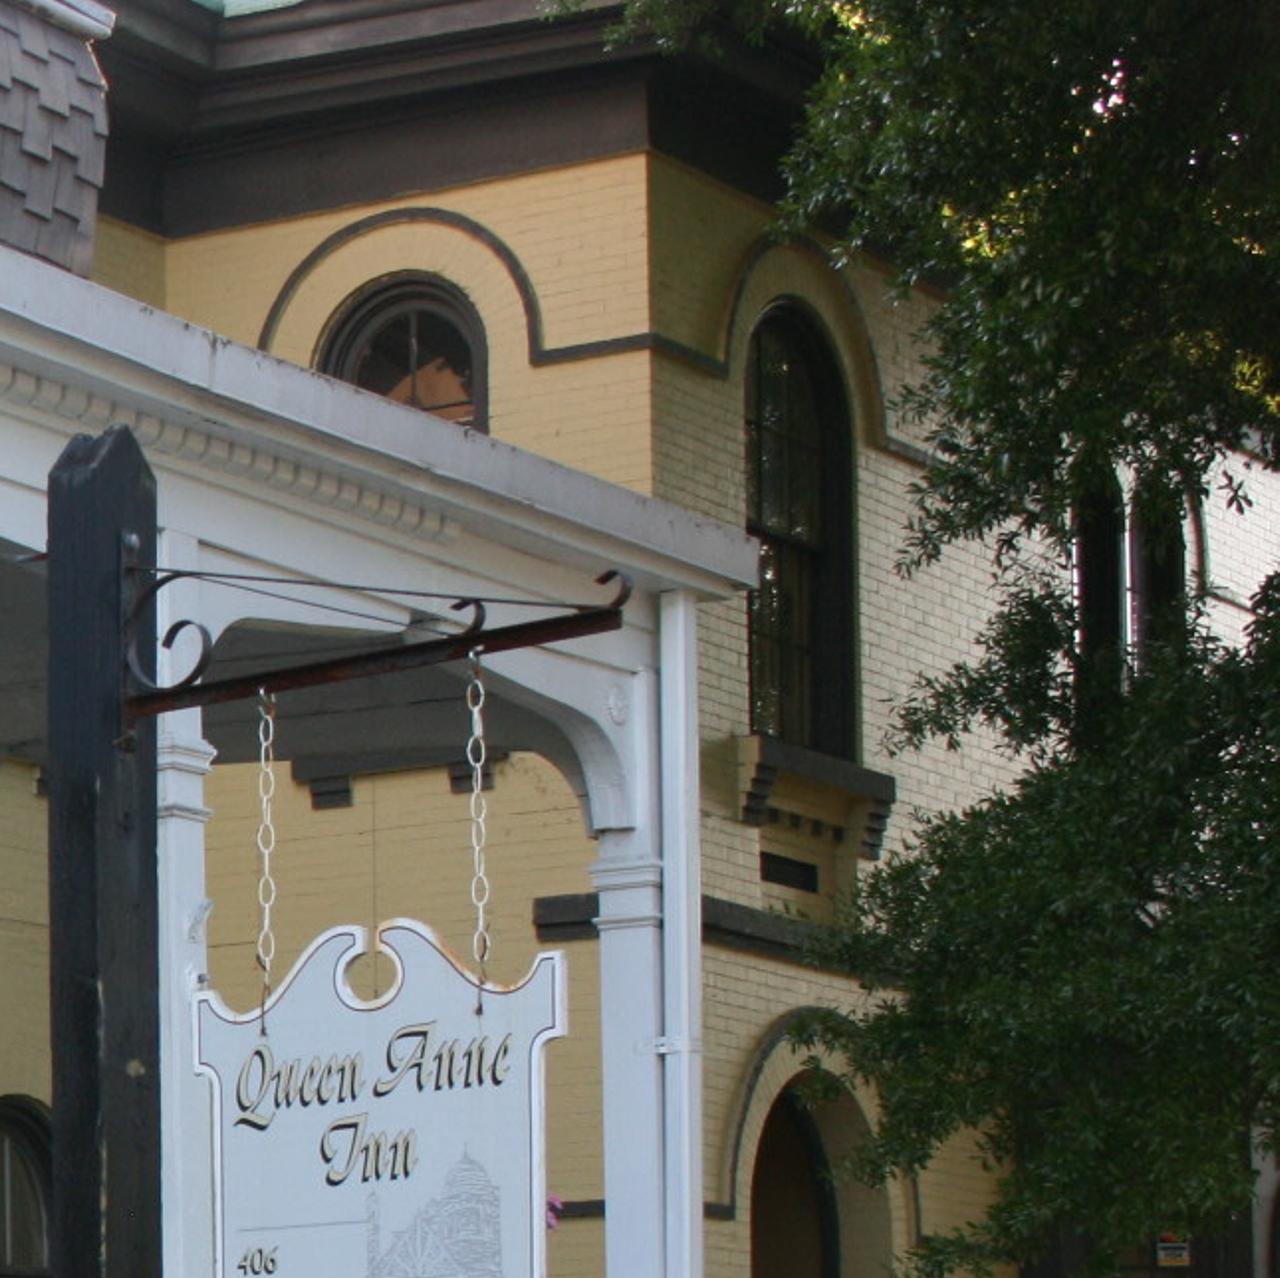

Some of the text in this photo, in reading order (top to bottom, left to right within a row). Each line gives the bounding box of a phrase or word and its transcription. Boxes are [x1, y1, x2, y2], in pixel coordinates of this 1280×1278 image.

[233, 1020, 512, 1131] Queen Anne
[320, 1112, 418, 1186] Inn
[237, 1246, 279, 1276] 406
